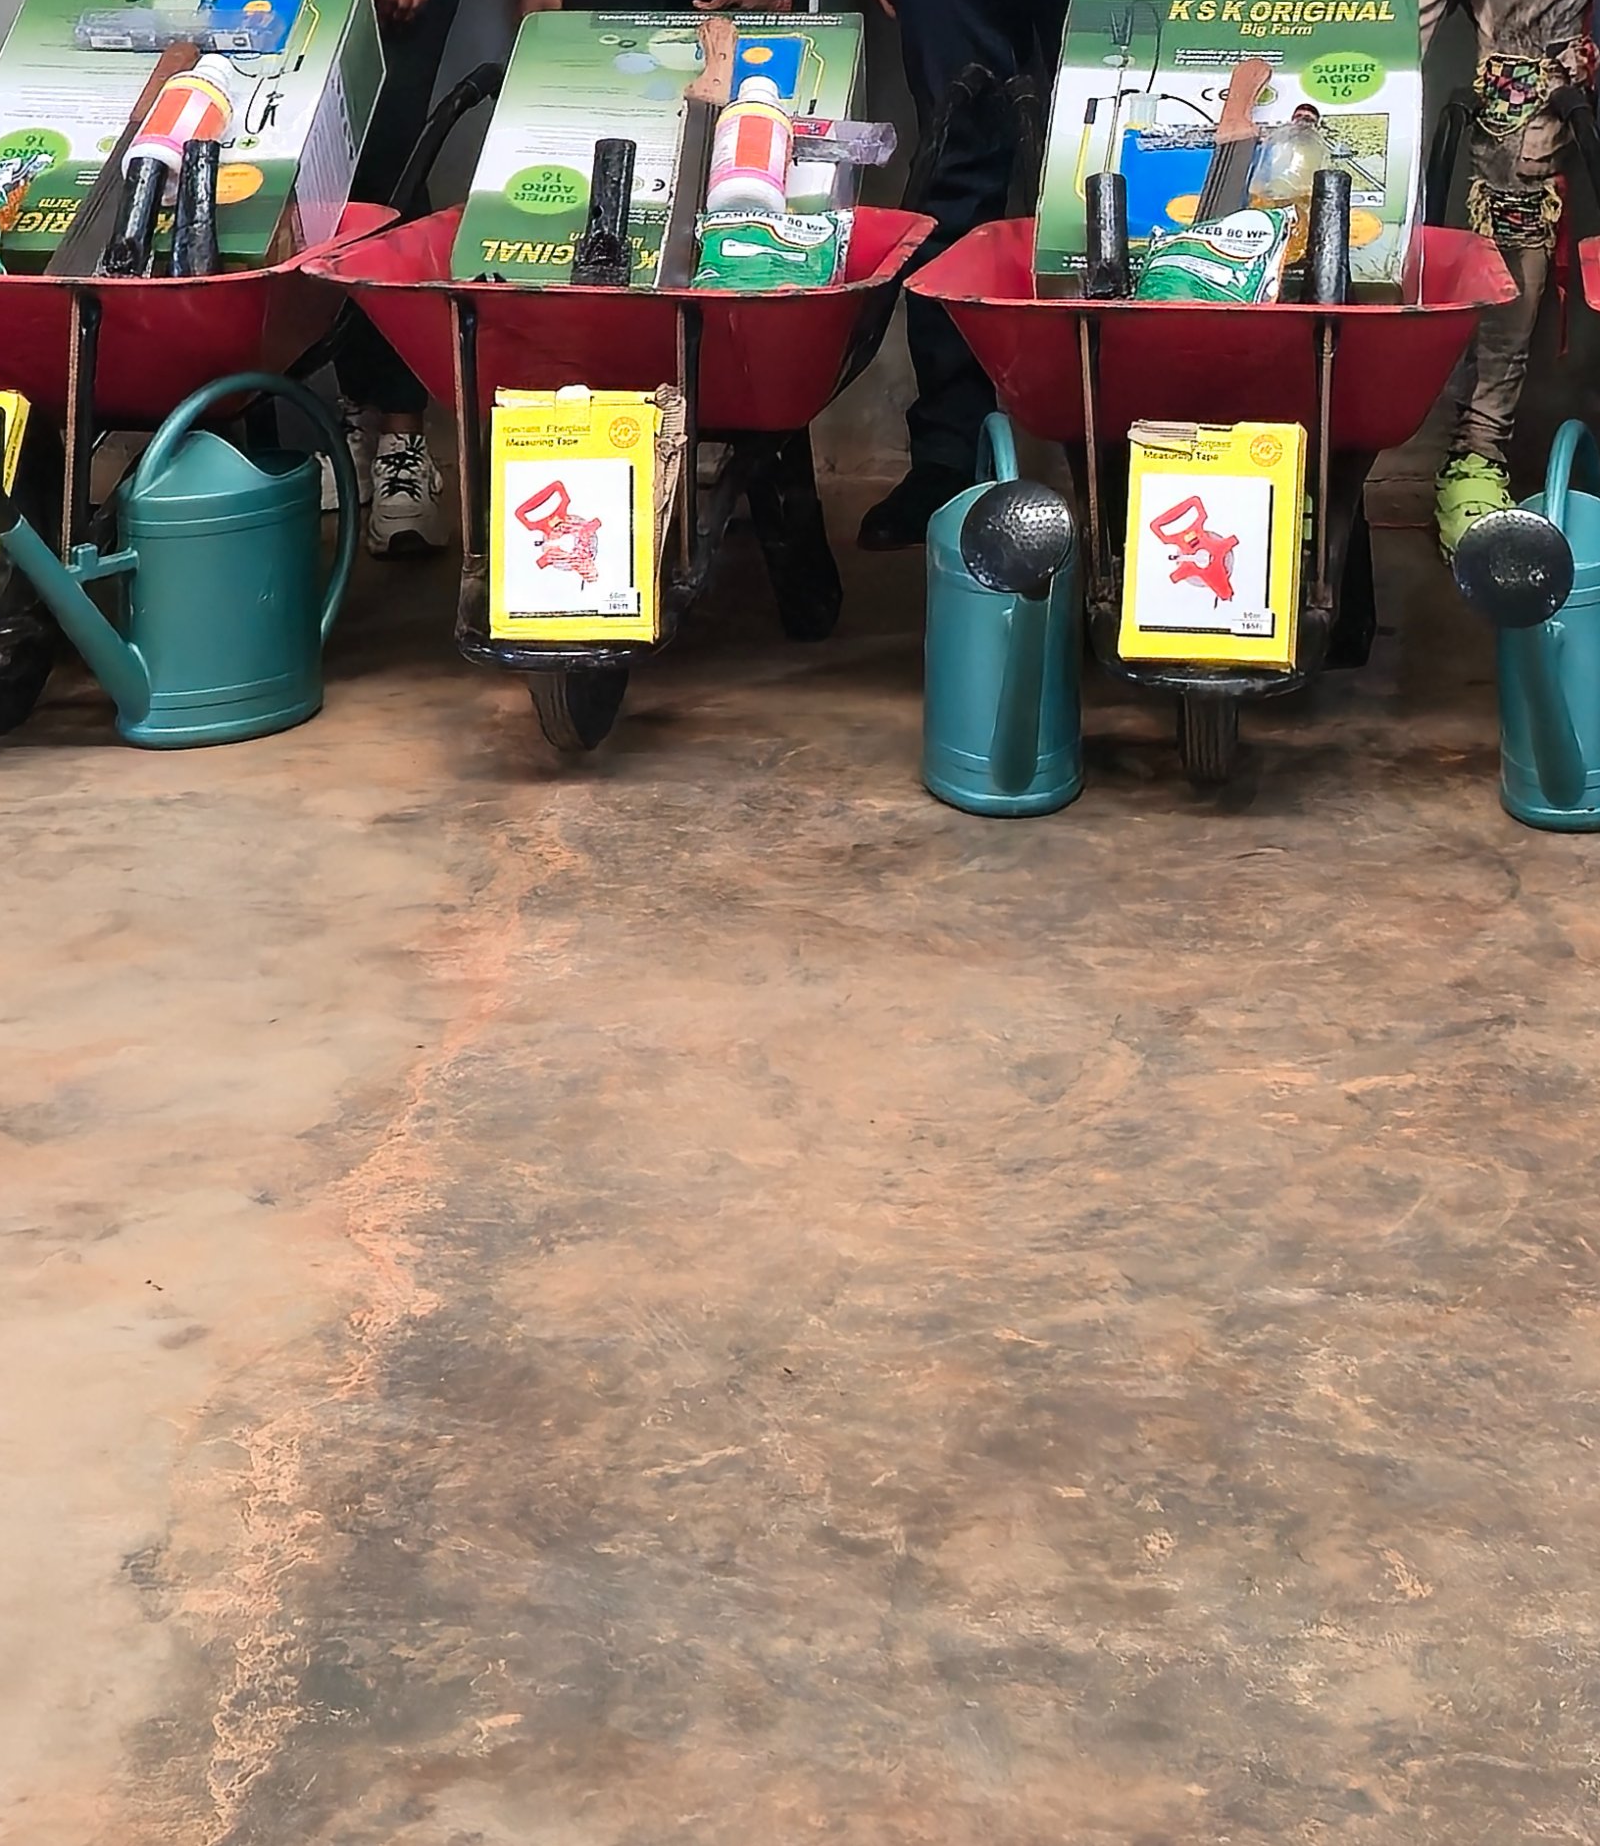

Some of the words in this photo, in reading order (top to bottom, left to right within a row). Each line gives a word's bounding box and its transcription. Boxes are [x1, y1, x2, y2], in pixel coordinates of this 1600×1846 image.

[1167, 0, 1195, 21] K
[1196, 0, 1219, 22] S
[1221, 0, 1249, 22] K
[1249, 0, 1396, 23] ORIGINAL
[1239, 22, 1268, 38] Big
[1270, 22, 1313, 36] Farm
[1312, 63, 1376, 74] SUPER
[1316, 74, 1370, 84] AGRO
[1330, 86, 1352, 97] 16
[25, 135, 45, 147] 16
[542, 171, 562, 181] 16
[521, 183, 575, 192] AGRO
[513, 192, 579, 204] SUPER
[39, 198, 82, 211] Farm
[787, 217, 802, 228] 80
[481, 238, 575, 265] GINAL
[505, 438, 554, 448] Measuring
[557, 438, 579, 446] Tape
[1196, 452, 1219, 461] Tape
